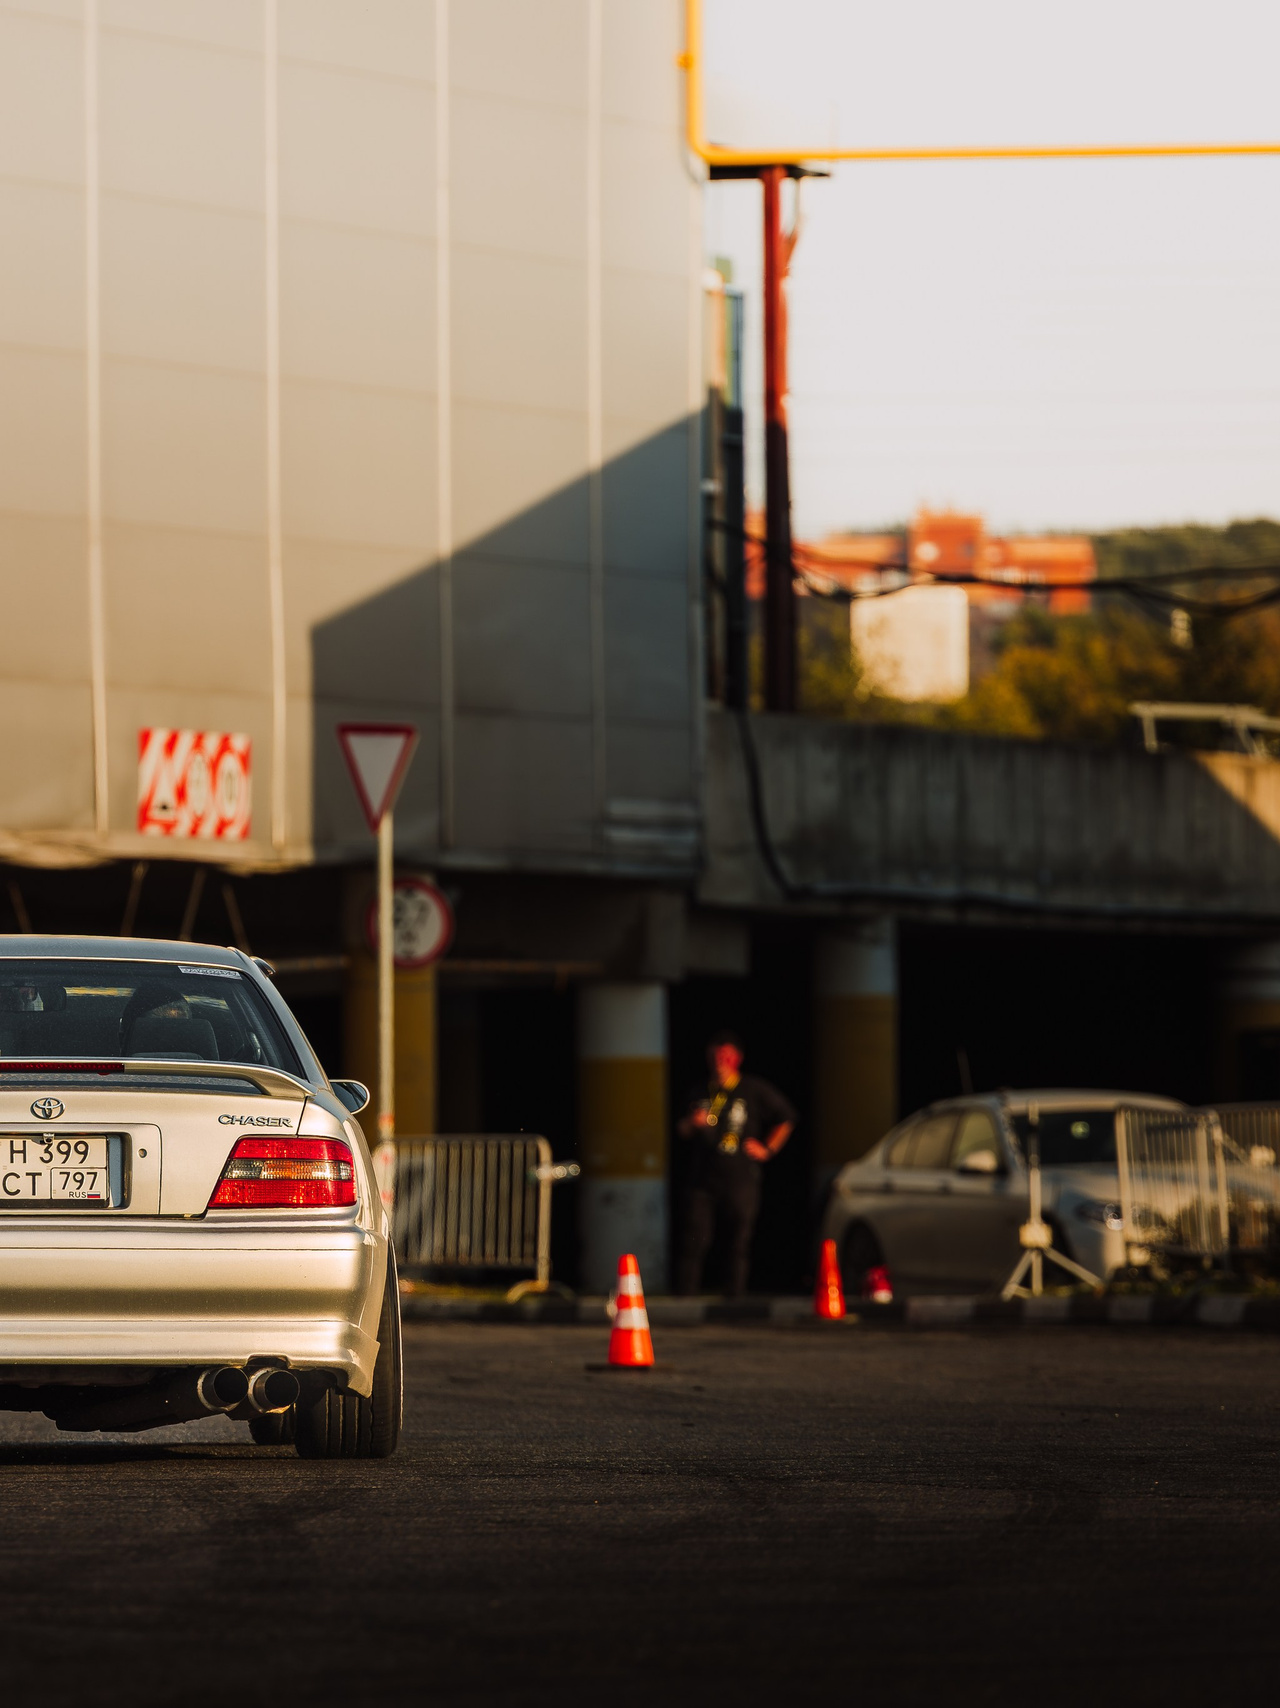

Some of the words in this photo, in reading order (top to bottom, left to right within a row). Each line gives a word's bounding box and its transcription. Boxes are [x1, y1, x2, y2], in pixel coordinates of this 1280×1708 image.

[218, 1114, 293, 1128] CHASER
[39, 1140, 89, 1164] 399
[59, 1171, 98, 1190] 797
[68, 1191, 87, 1199] RUS
